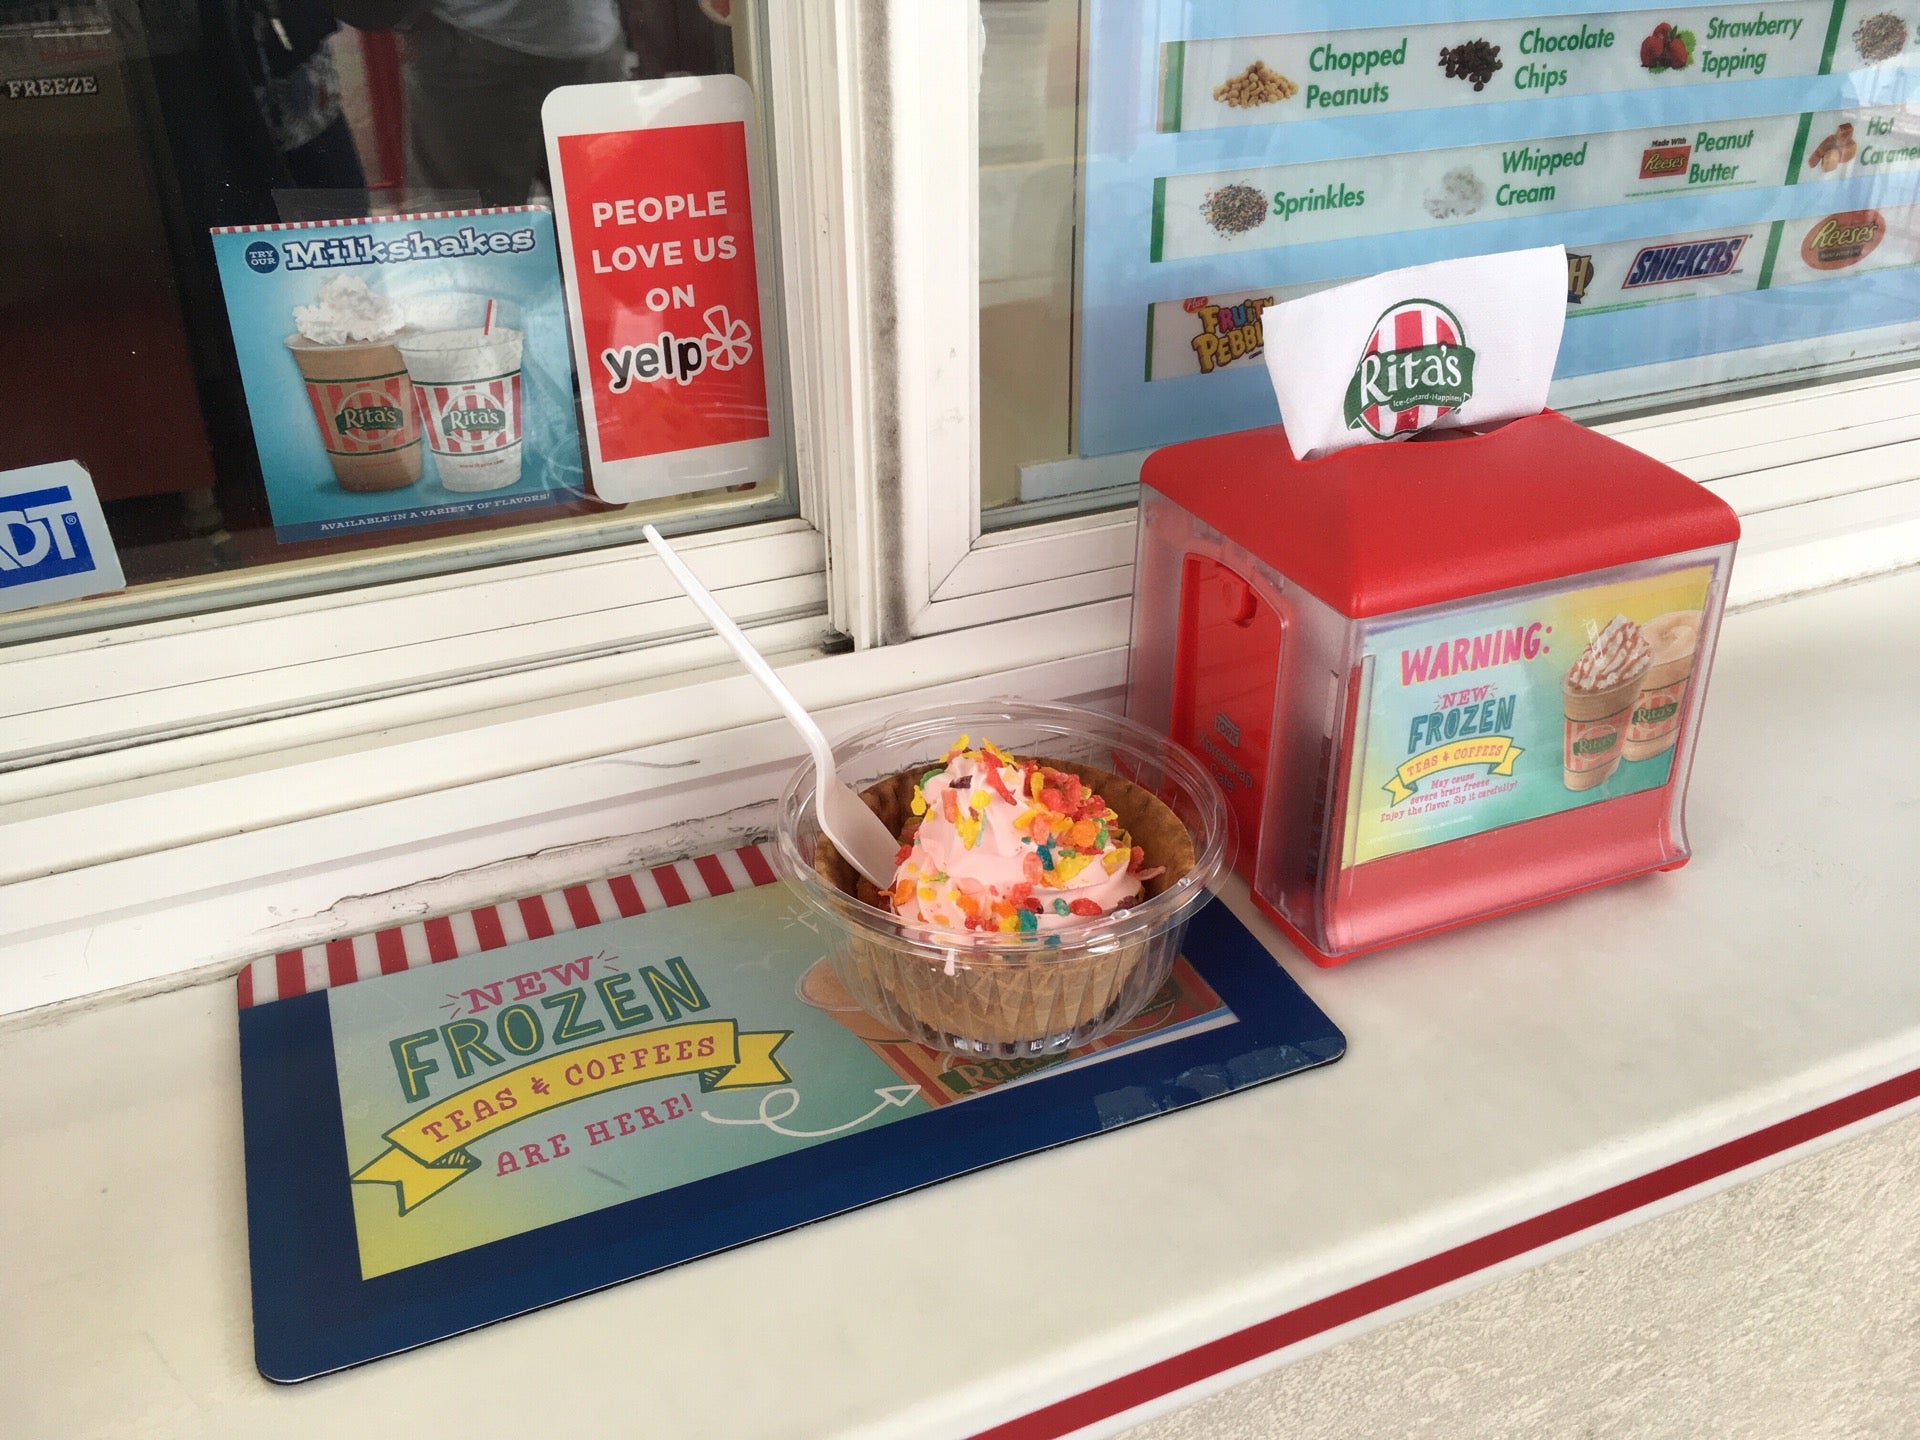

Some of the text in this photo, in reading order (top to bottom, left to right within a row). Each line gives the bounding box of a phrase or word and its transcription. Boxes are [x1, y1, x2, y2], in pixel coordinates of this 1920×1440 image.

[1519, 23, 1615, 55] Chocolate
[1705, 12, 1802, 41] Strawberry
[1308, 38, 1408, 79] Chopped
[1701, 49, 1767, 79] Topping
[6, 76, 98, 99] FREEZE
[1514, 64, 1567, 94] Chips
[1305, 82, 1389, 109] Peanuts
[1866, 116, 1895, 136] Hot
[1694, 130, 1755, 153] Peanut
[1860, 145, 1920, 166] Carame
[1502, 142, 1588, 178] Whipped
[1688, 163, 1740, 184] Butter
[591, 189, 728, 229] PEOPLE
[1272, 183, 1366, 221] Sprinkles
[1495, 184, 1556, 208] Cream
[282, 227, 536, 270] Milkshakes
[1810, 219, 1879, 250] Reese's
[249, 249, 275, 260] TRY
[250, 256, 277, 267] OUR
[591, 234, 738, 275] LOVE US
[1627, 238, 1743, 286] SNICKERS
[645, 284, 696, 313] ON
[603, 333, 705, 392] yelp
[1357, 344, 1463, 409] Rita's
[344, 405, 398, 429] Rita's
[449, 408, 500, 431] Rita's
[320, 492, 551, 532] AVAILABLE IN A VARIETY OF FLAVORS!
[1399, 620, 1553, 688] WARNING:
[1440, 684, 1490, 710] NEW
[1407, 694, 1517, 755] FROZEN
[1406, 754, 1439, 777] TEAS
[1453, 744, 1504, 761] COFFEES
[1410, 778, 1490, 805] severe brain freeze
[1431, 772, 1475, 790] May cause
[1380, 809, 1405, 823] Enjoy
[1407, 805, 1422, 816] the
[1453, 795, 1467, 806] Sip
[461, 955, 596, 1015] NEW
[389, 955, 712, 1104] FROZEN
[421, 1035, 716, 1144] TEAS & COFFEES
[495, 1092, 694, 1178] ARE HERE!
